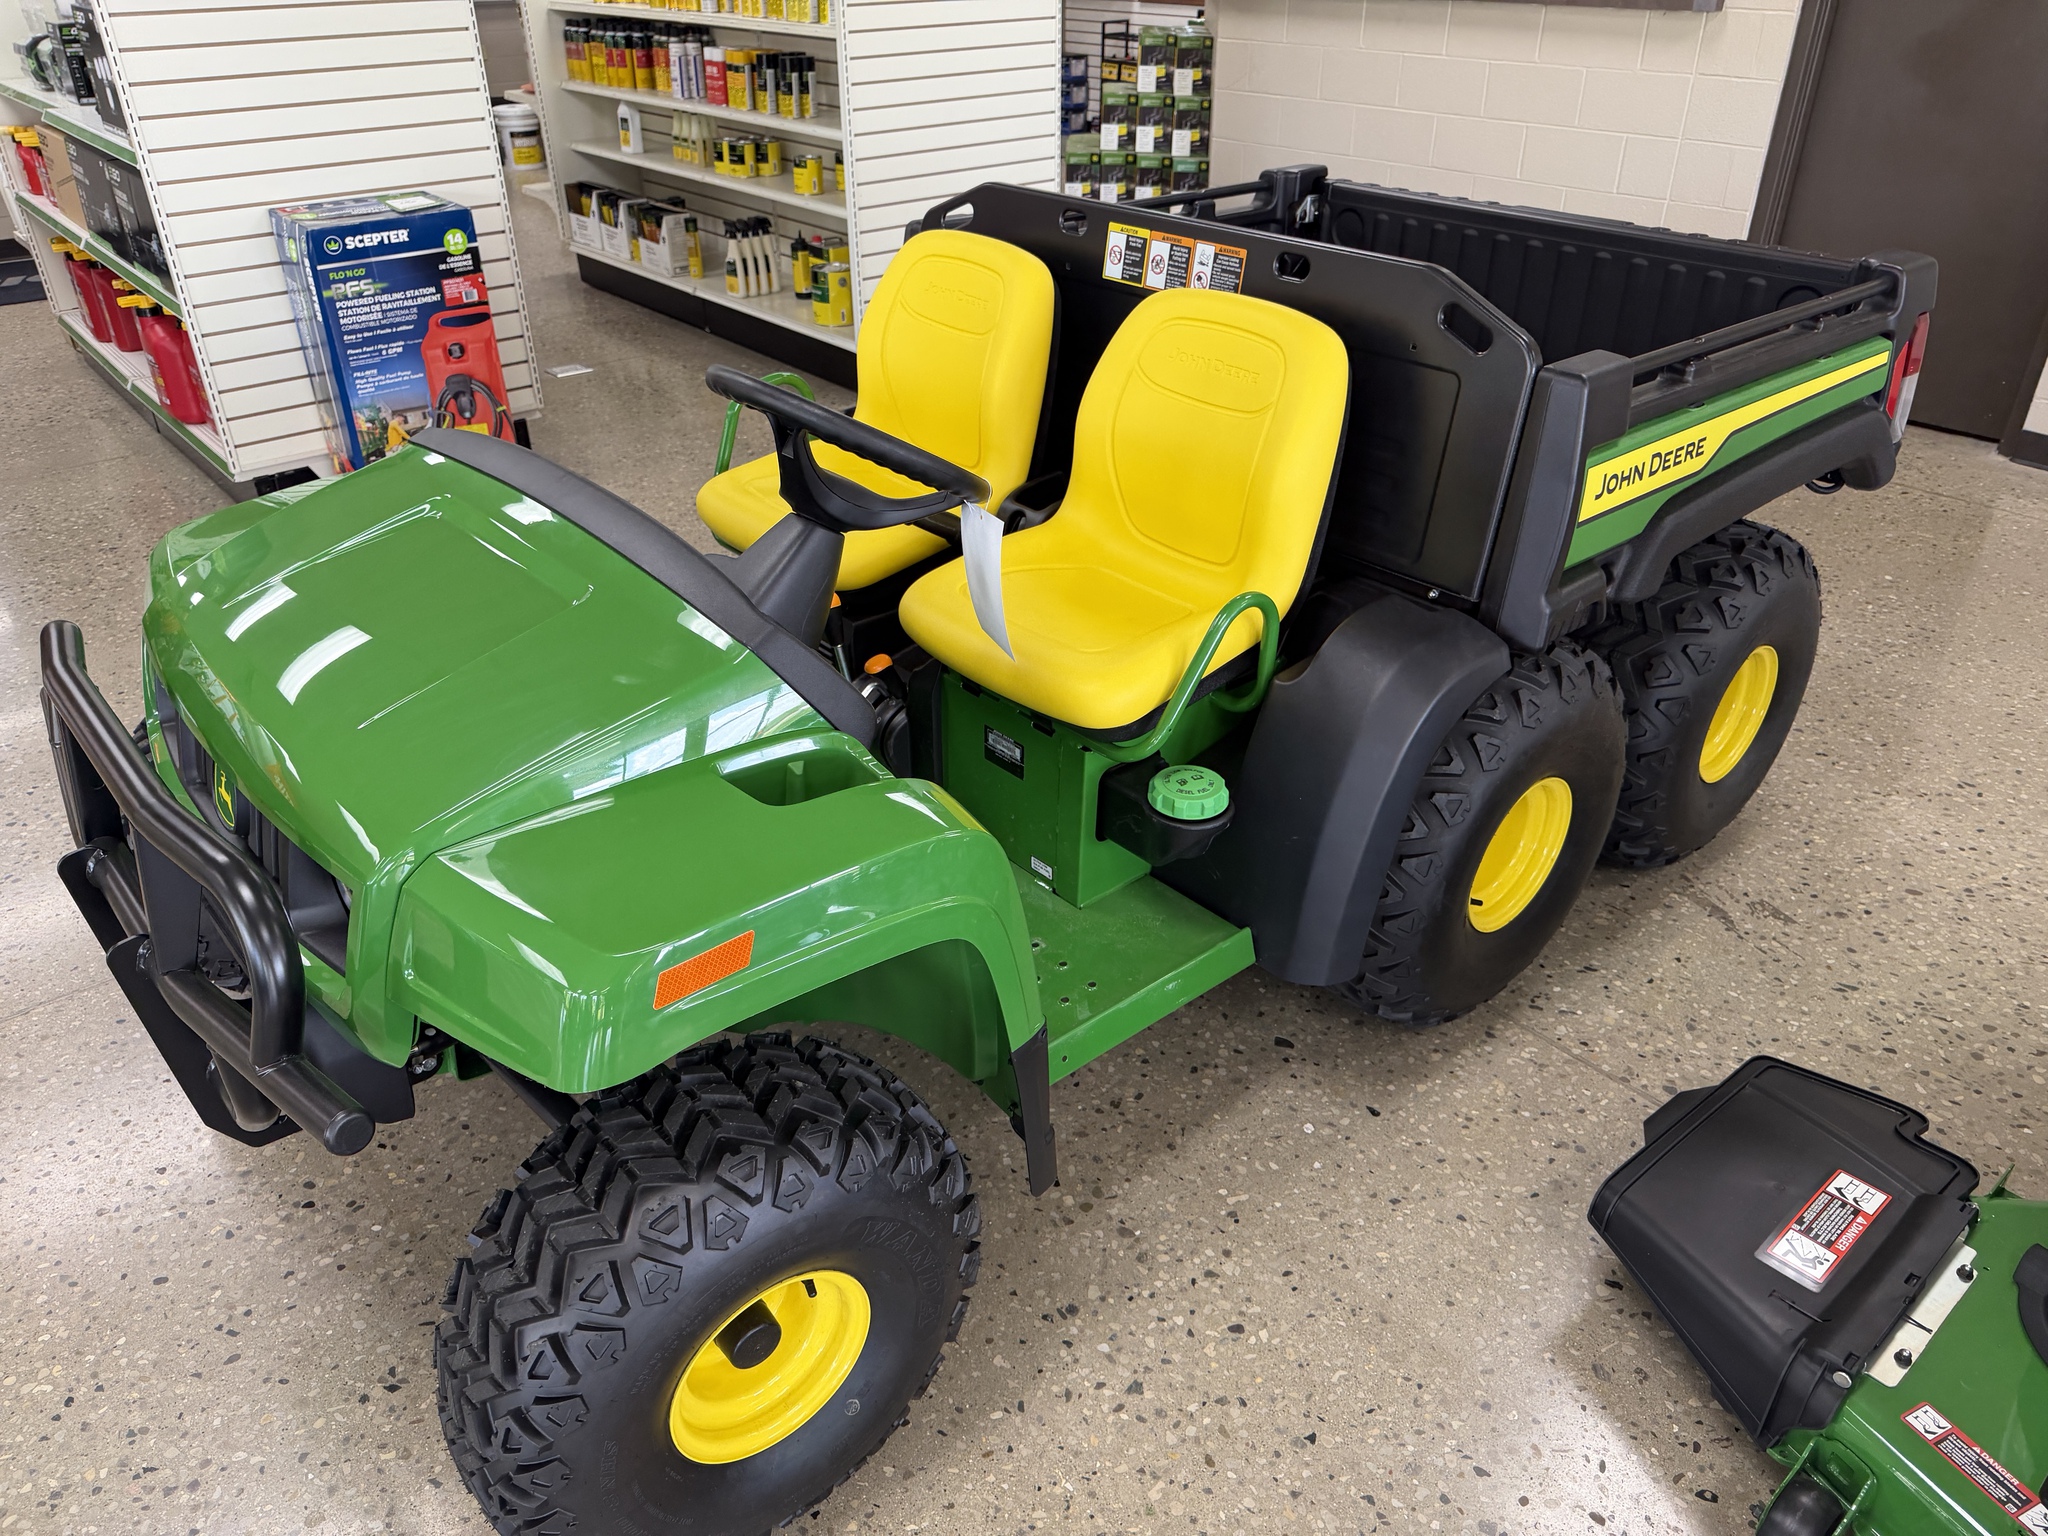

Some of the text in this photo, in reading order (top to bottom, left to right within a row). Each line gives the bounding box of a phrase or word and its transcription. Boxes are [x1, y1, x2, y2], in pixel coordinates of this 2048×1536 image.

[345, 228, 409, 250] SCEPTER
[447, 233, 463, 245] 14
[1166, 236, 1183, 244] WARNING
[1222, 248, 1241, 256] WARNING
[329, 271, 344, 280] FLO
[353, 267, 366, 276] GO
[331, 279, 376, 299] PFS
[336, 297, 374, 309] POWERED
[375, 292, 405, 303] FUELING
[405, 286, 436, 298] STATION
[338, 293, 441, 317] STATION DE RAVITAILLEMENT
[340, 312, 383, 325] MOTORISÉE
[380, 314, 418, 325] MOTORIZADO
[388, 346, 403, 354] GPM
[1168, 346, 1261, 384] JOHN DEERE
[1594, 437, 1707, 501] JOHN DEERE
[1834, 1221, 1862, 1251] DANGER
[860, 1220, 942, 1327] WANDA
[1980, 1451, 2020, 1486] DANGER
